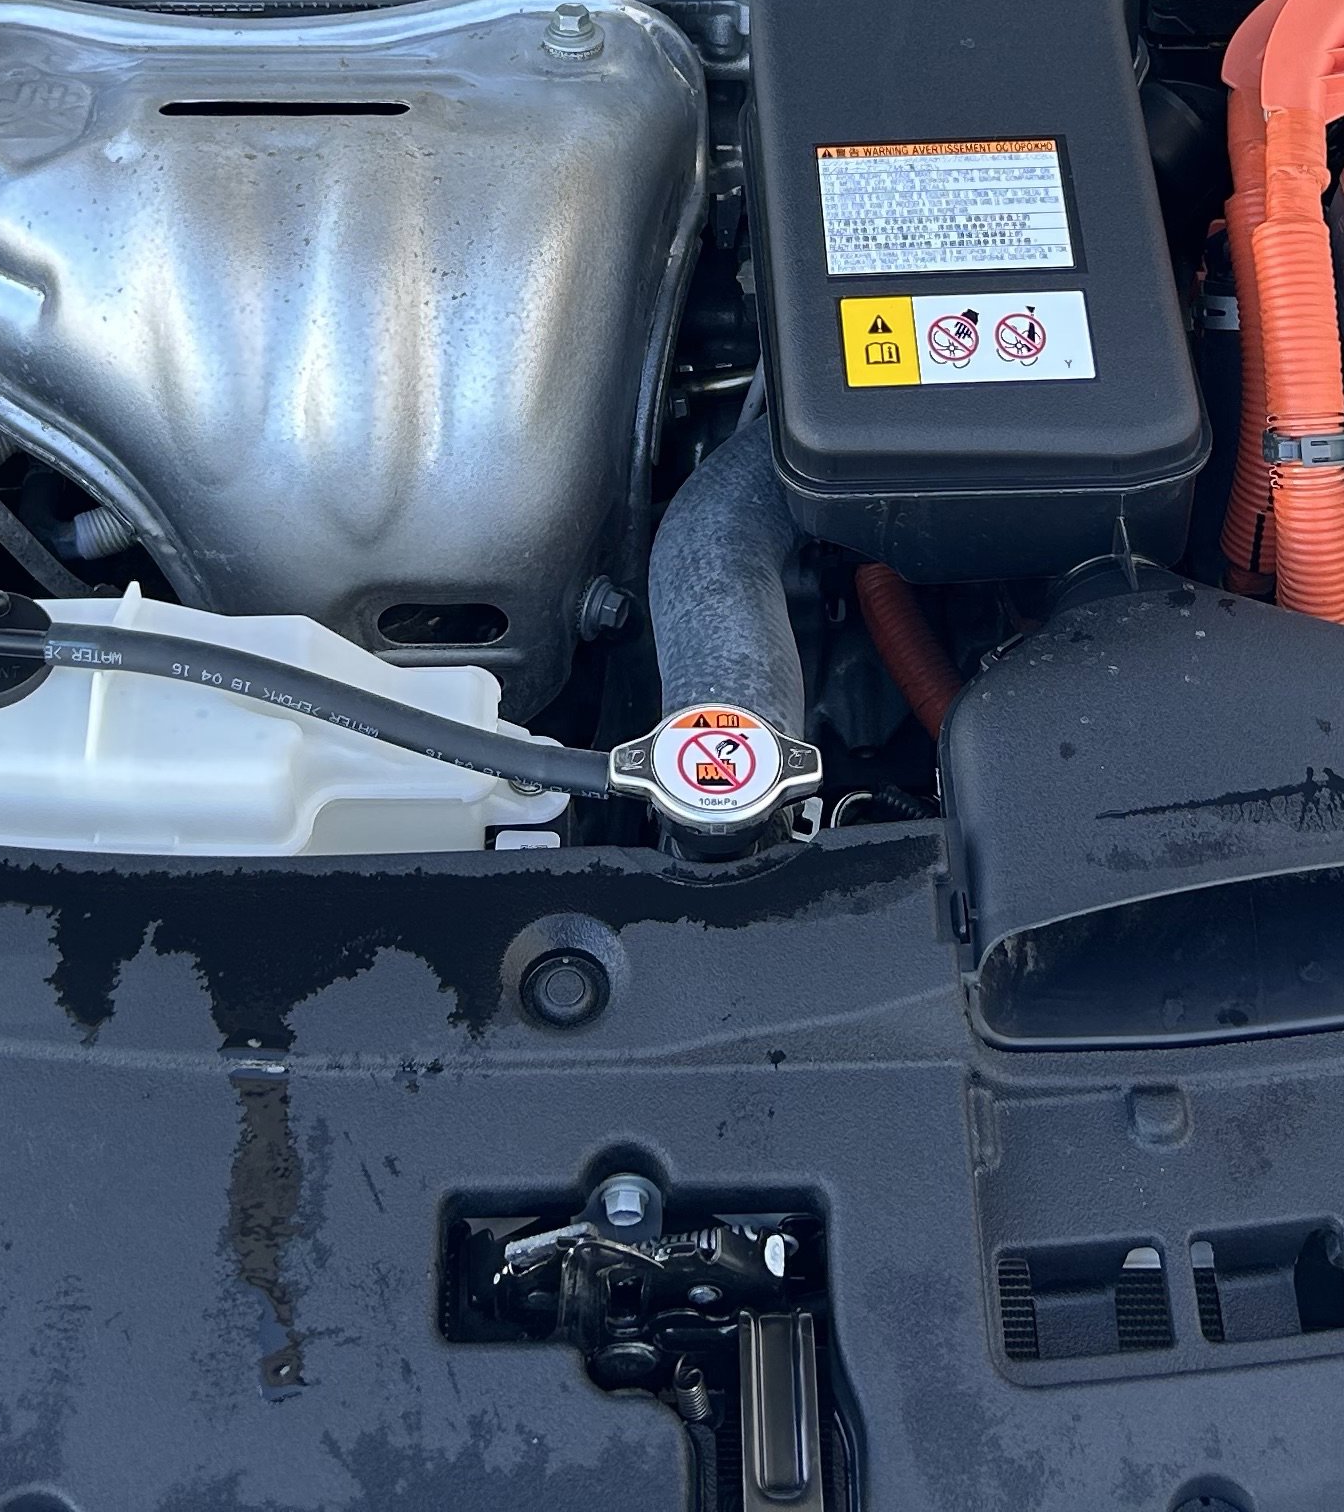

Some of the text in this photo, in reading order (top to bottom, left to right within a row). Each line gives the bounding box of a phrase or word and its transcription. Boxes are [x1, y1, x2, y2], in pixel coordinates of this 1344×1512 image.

[863, 143, 992, 157] WARNING AVERTISSEMENT
[72, 648, 122, 665] WATER
[172, 662, 190, 678] 16
[200, 668, 223, 685] 04
[232, 677, 252, 693] 18
[328, 711, 379, 738] WATER
[698, 797, 738, 807] 108kPa
